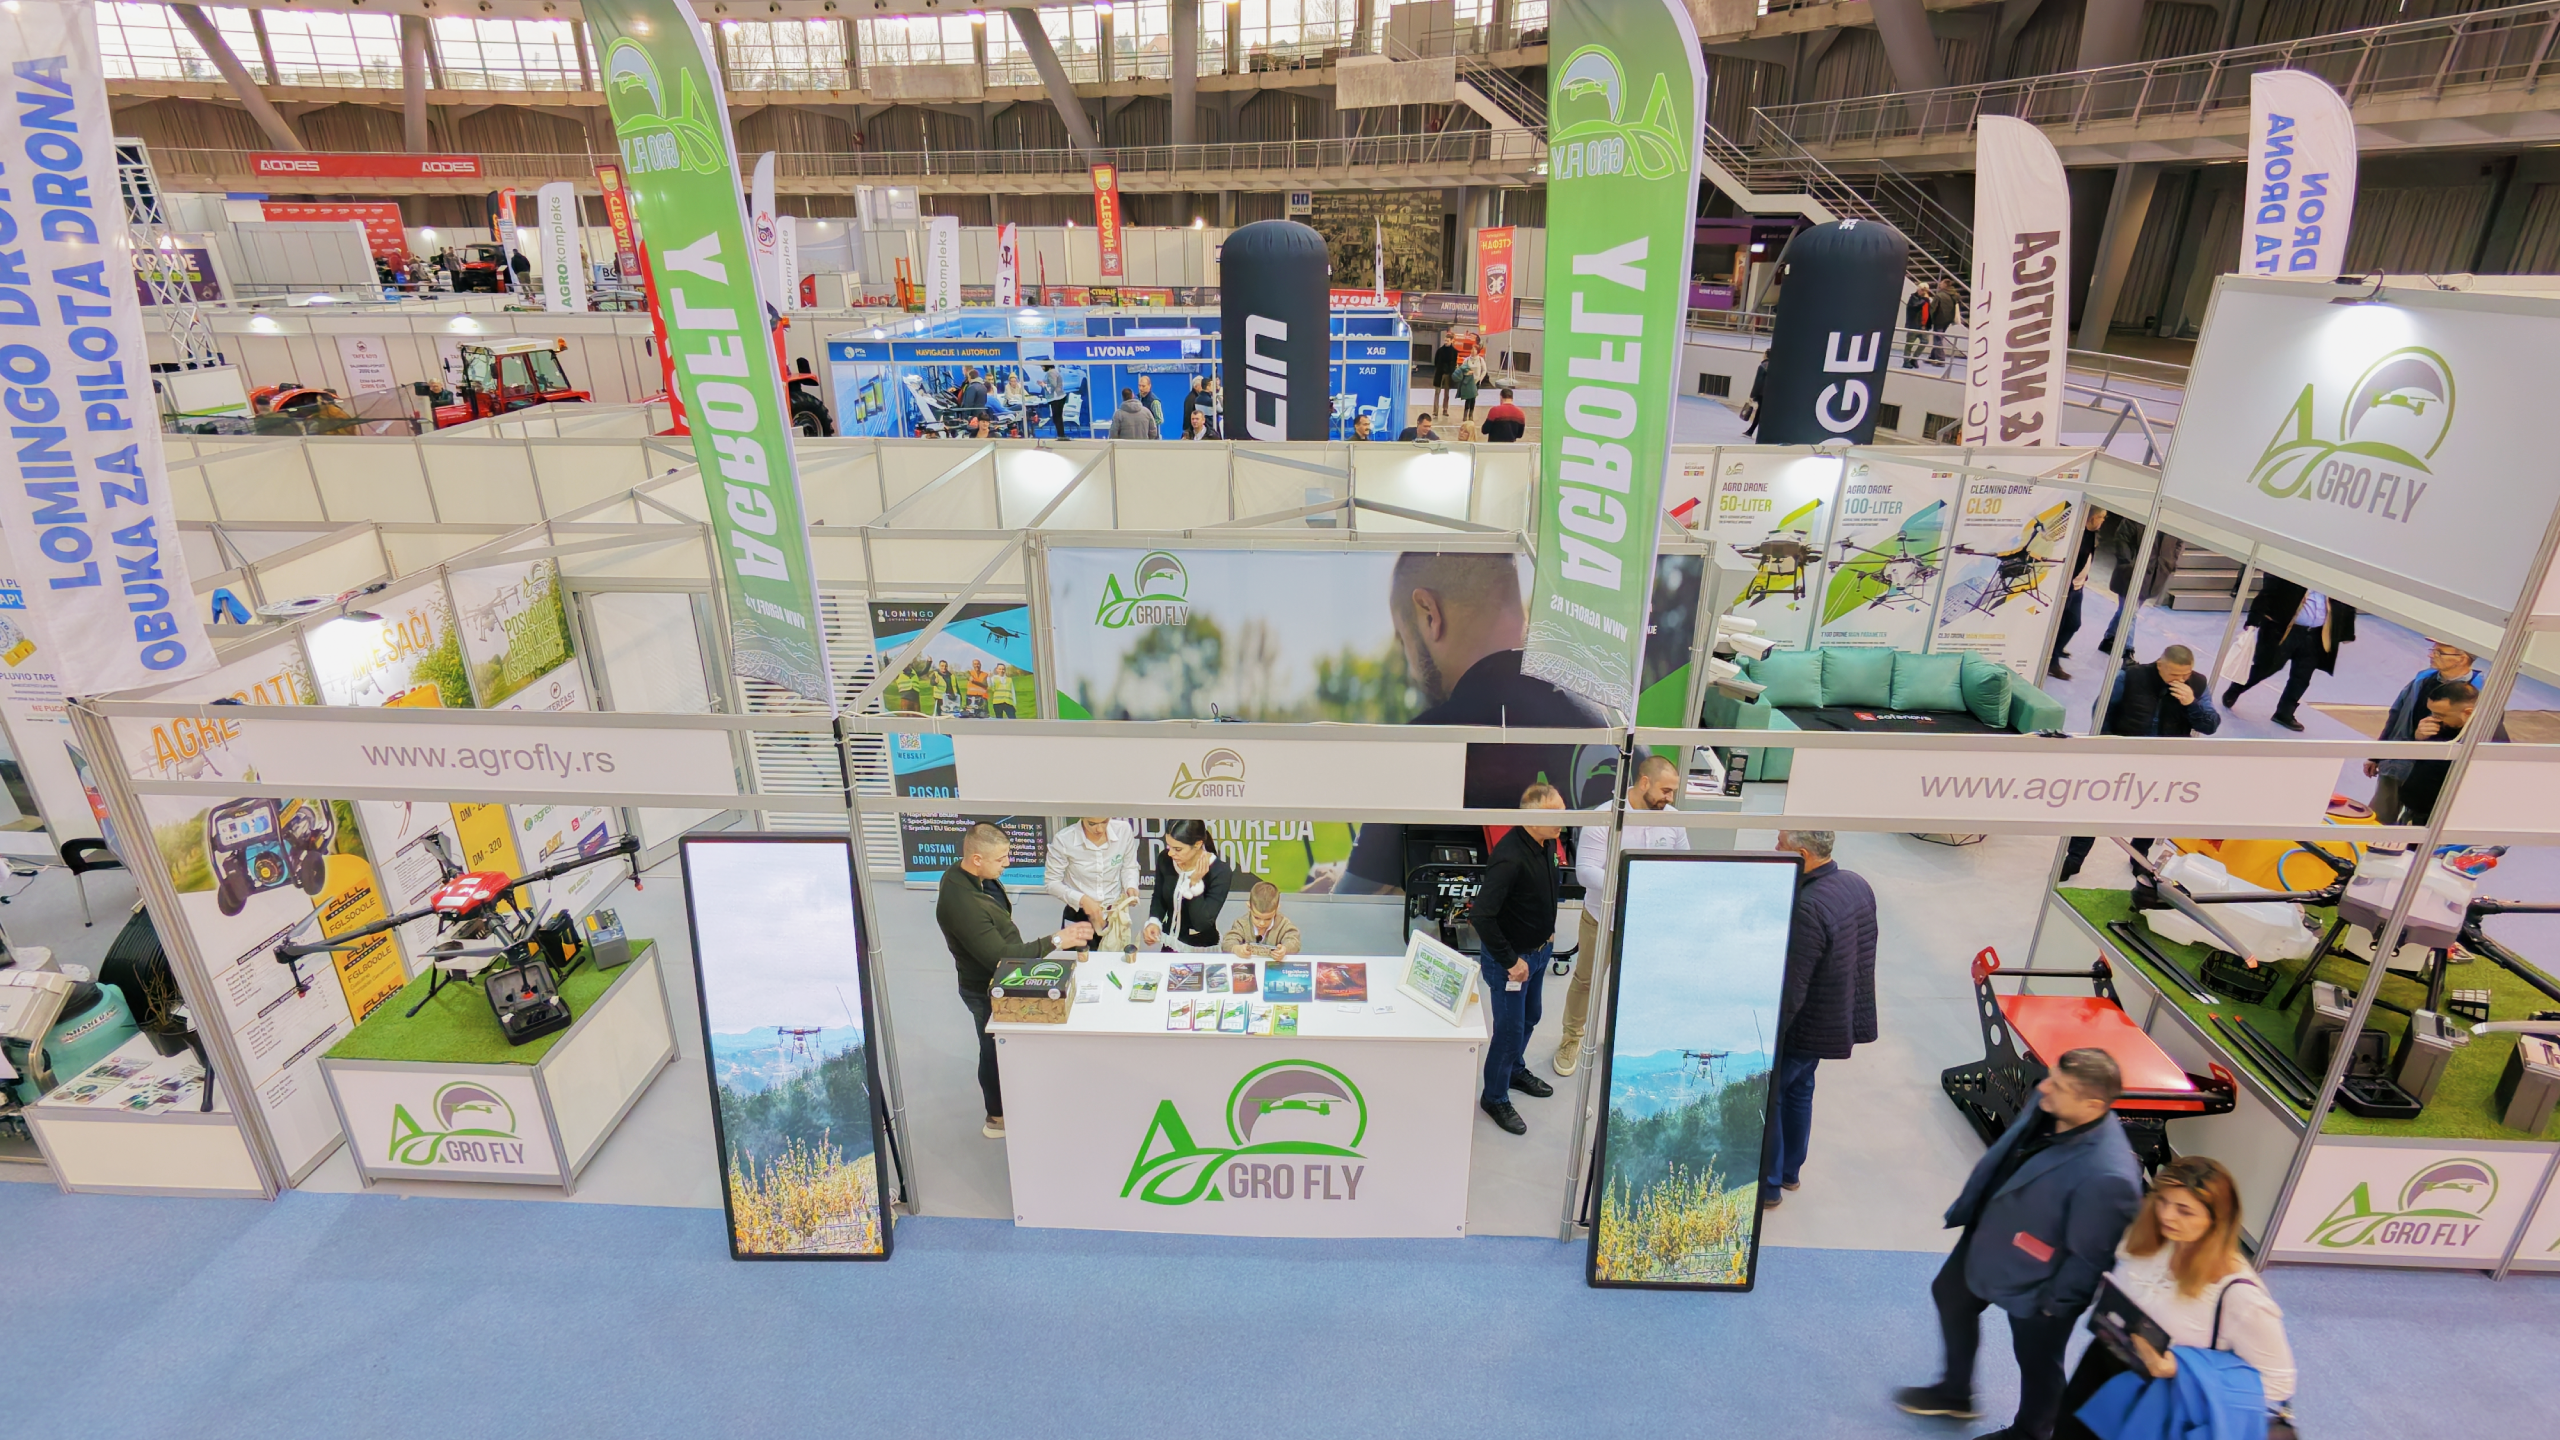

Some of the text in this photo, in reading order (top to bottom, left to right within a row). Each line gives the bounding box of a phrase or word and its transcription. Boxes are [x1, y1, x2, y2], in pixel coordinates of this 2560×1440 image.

[260, 160, 320, 172] AODES
[421, 161, 476, 172] AODES
[551, 196, 573, 309] AGROkompleks
[937, 230, 949, 310] Okompleks
[12, 55, 187, 671] OBUKA ZA PILOTA DRONA
[1086, 347, 1135, 357] LIVONA
[0, 344, 102, 590] LOMINGO
[1970, 485, 2008, 495] CLEANING
[2367, 472, 2428, 524] FLY
[1720, 495, 1772, 512] 50-LITER
[1844, 497, 1904, 515] 100-LITER
[885, 610, 934, 618] LOMINGO
[1164, 605, 1188, 626] FLY
[362, 743, 616, 778] www.agrofly.rs
[1226, 784, 1245, 798] FLY
[1921, 771, 2202, 809] www.agrofly.rs
[918, 843, 955, 855] POSTANI
[912, 855, 937, 866] DRON
[363, 984, 397, 1012] FULL
[491, 1141, 525, 1165] FLY
[1303, 1164, 1365, 1201] FLY
[2430, 1222, 2480, 1247] FLY
